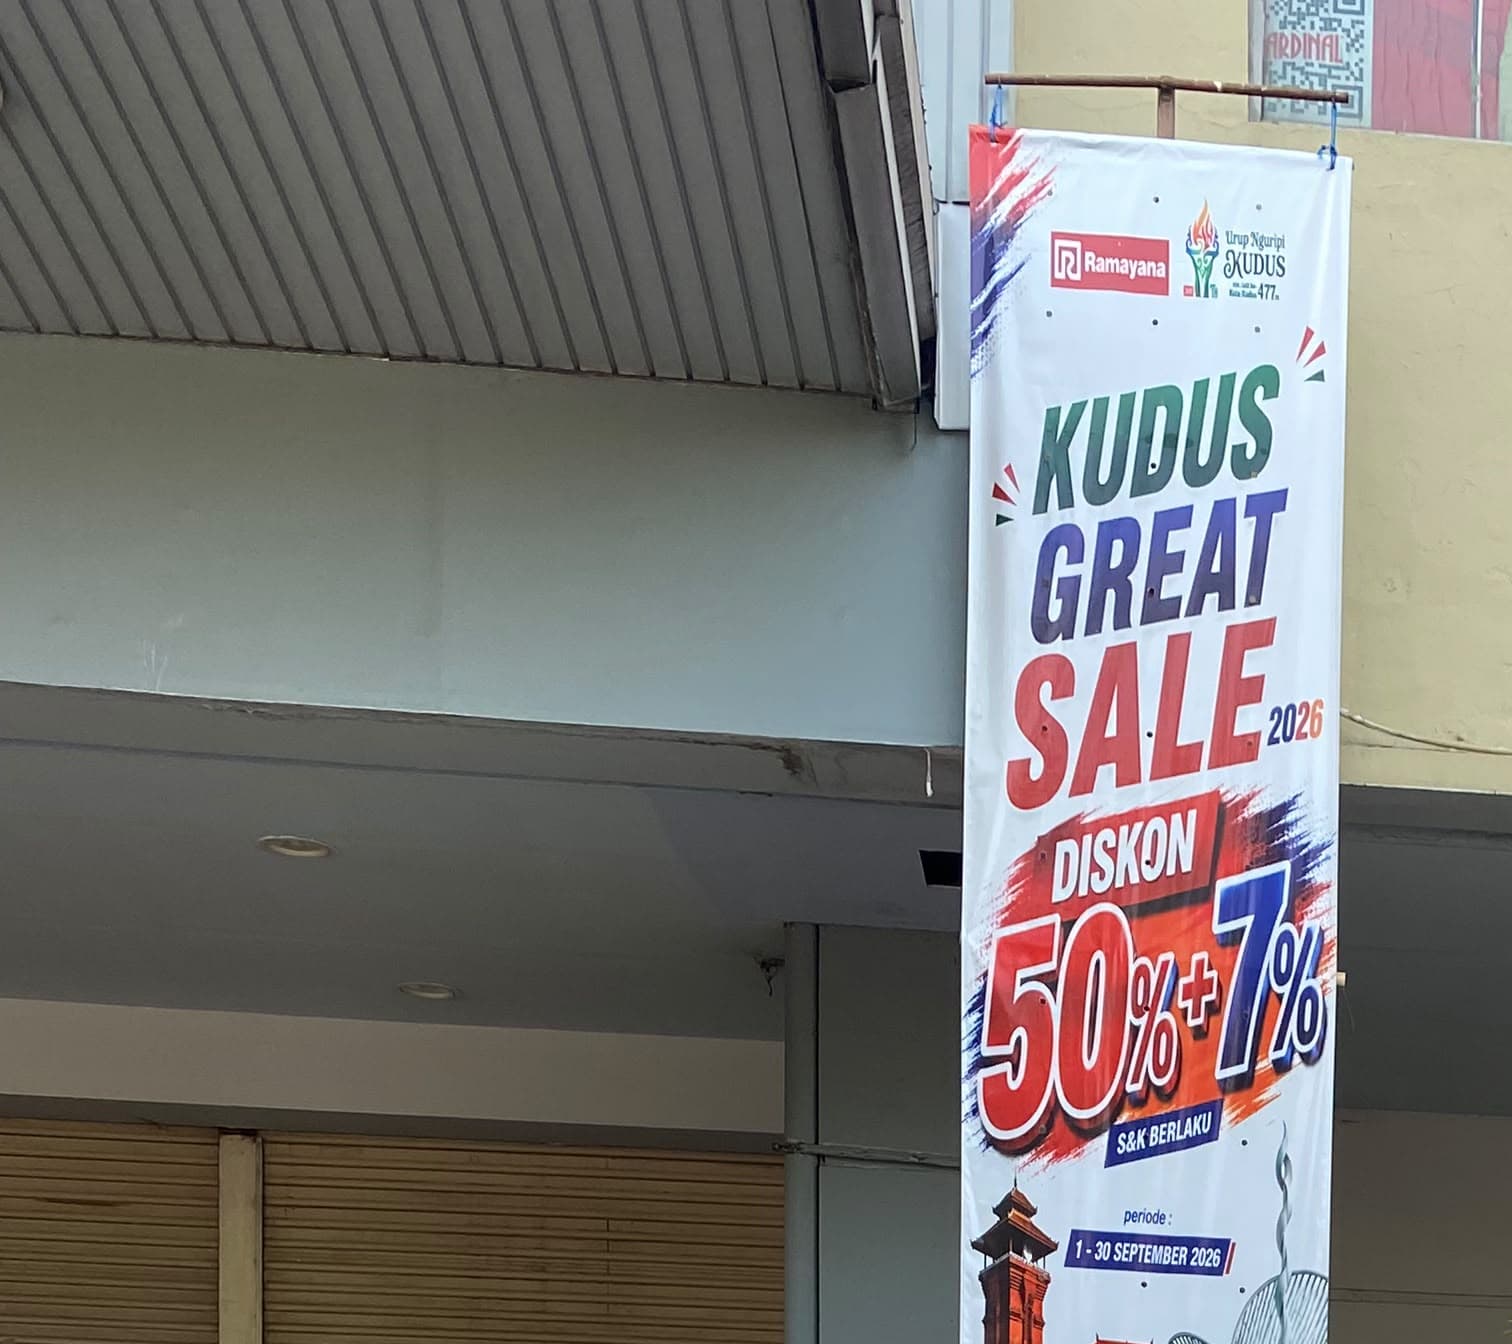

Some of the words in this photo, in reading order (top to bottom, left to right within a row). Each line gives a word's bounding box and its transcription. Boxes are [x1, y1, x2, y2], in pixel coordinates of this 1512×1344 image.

[1264, 31, 1343, 63] ARDINAL
[1225, 230, 1249, 249] Urup
[1250, 231, 1285, 252] Nguripi
[1084, 250, 1166, 280] Ramayana
[1223, 249, 1286, 279] KUDUS
[1032, 364, 1280, 515] KUDUS
[1030, 488, 1289, 644] GREAT
[1006, 617, 1277, 810] SALE
[1267, 699, 1325, 746] 2026
[1051, 808, 1197, 903] DISKON
[1116, 1128, 1146, 1154] S&K
[1149, 1111, 1213, 1147] BERLAKU
[1123, 1208, 1166, 1225] periode
[1075, 1239, 1083, 1259] 1
[1094, 1240, 1111, 1261] 30
[1113, 1242, 1187, 1265] SEPTEMBER
[1189, 1247, 1221, 1267] 2026
